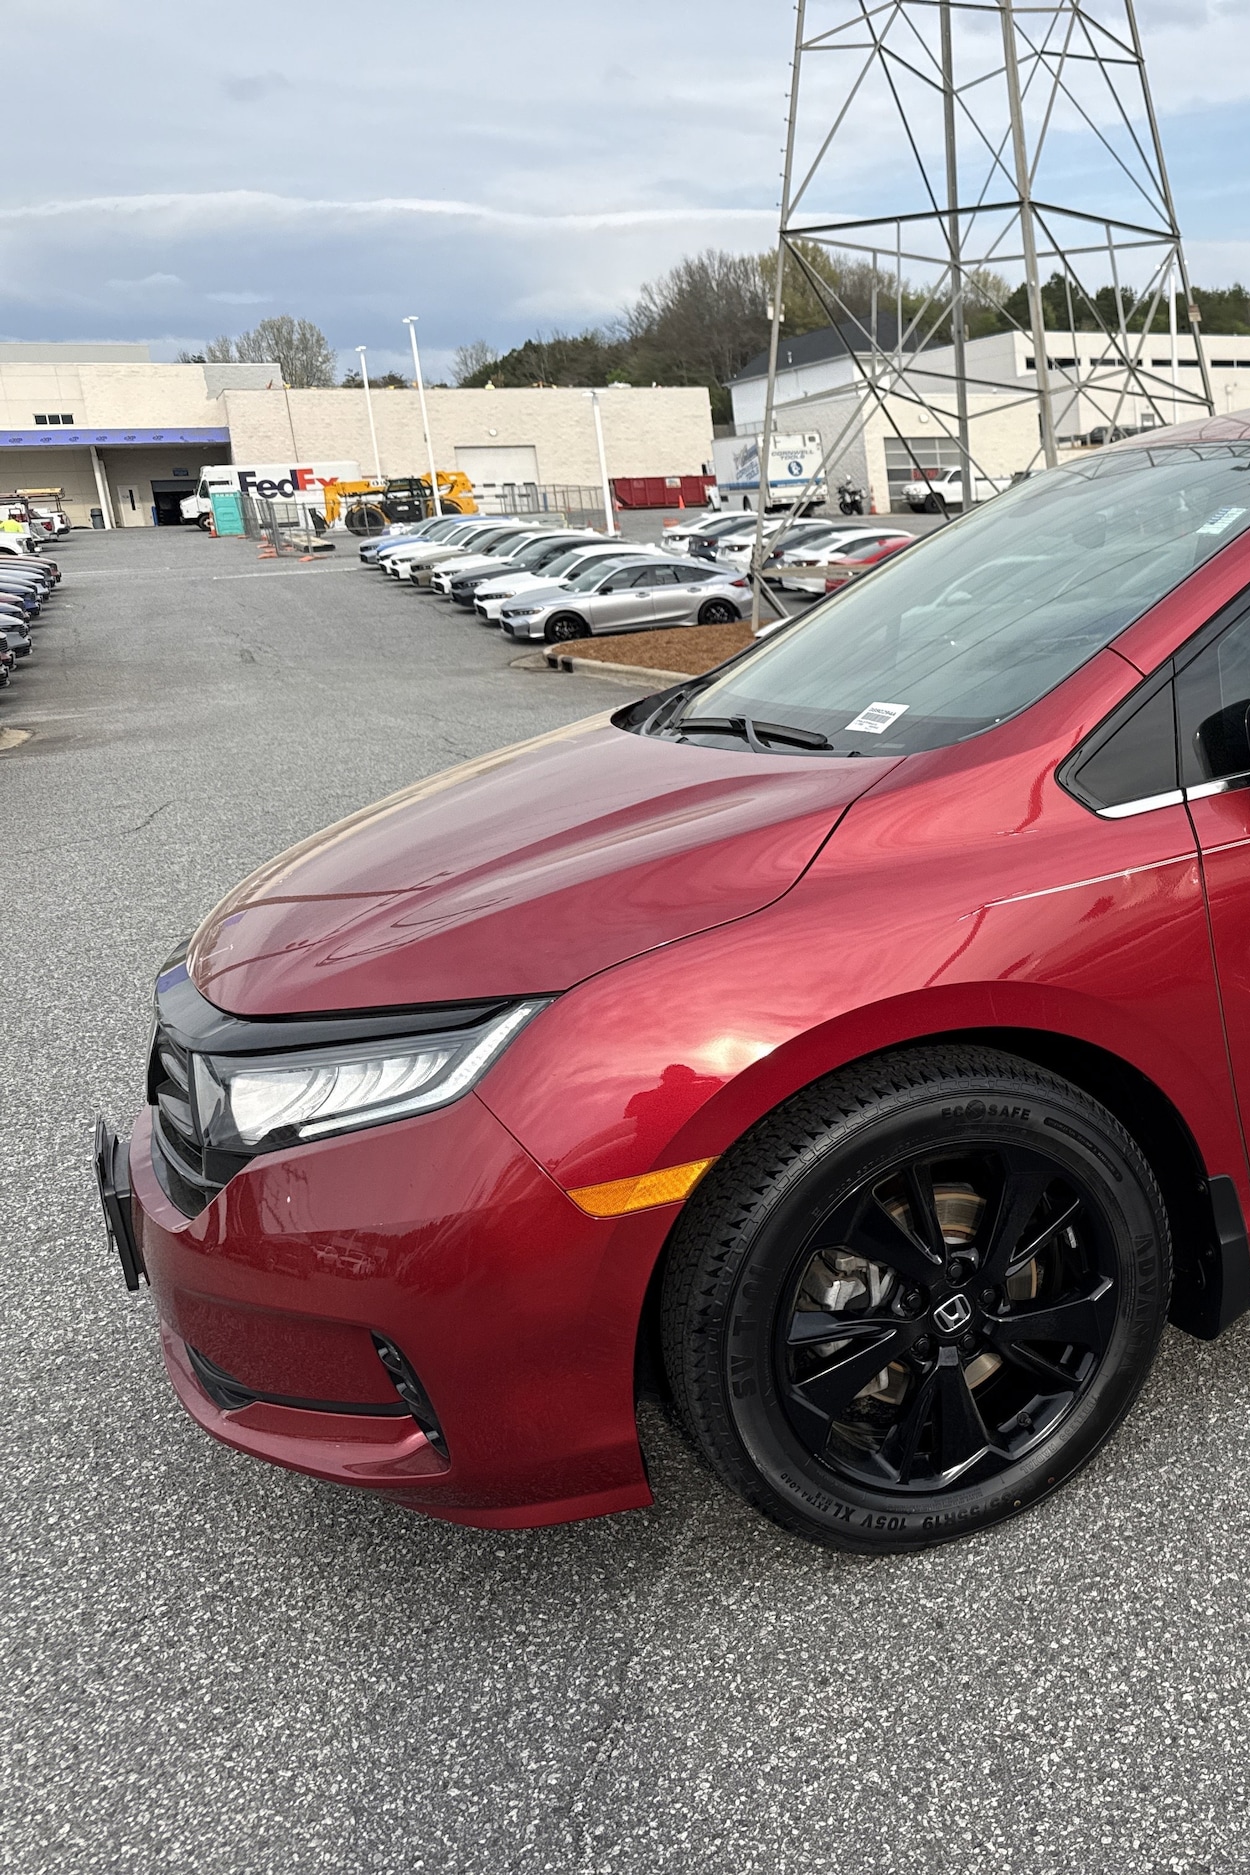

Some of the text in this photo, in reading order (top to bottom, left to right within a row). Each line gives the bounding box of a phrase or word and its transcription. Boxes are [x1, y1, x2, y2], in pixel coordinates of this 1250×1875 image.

[1020, 1444, 1058, 1475] RADIAL
[780, 1472, 828, 1512] EXTRA LOAD
[832, 1502, 856, 1522] XL
[860, 1513, 908, 1531] 105V
